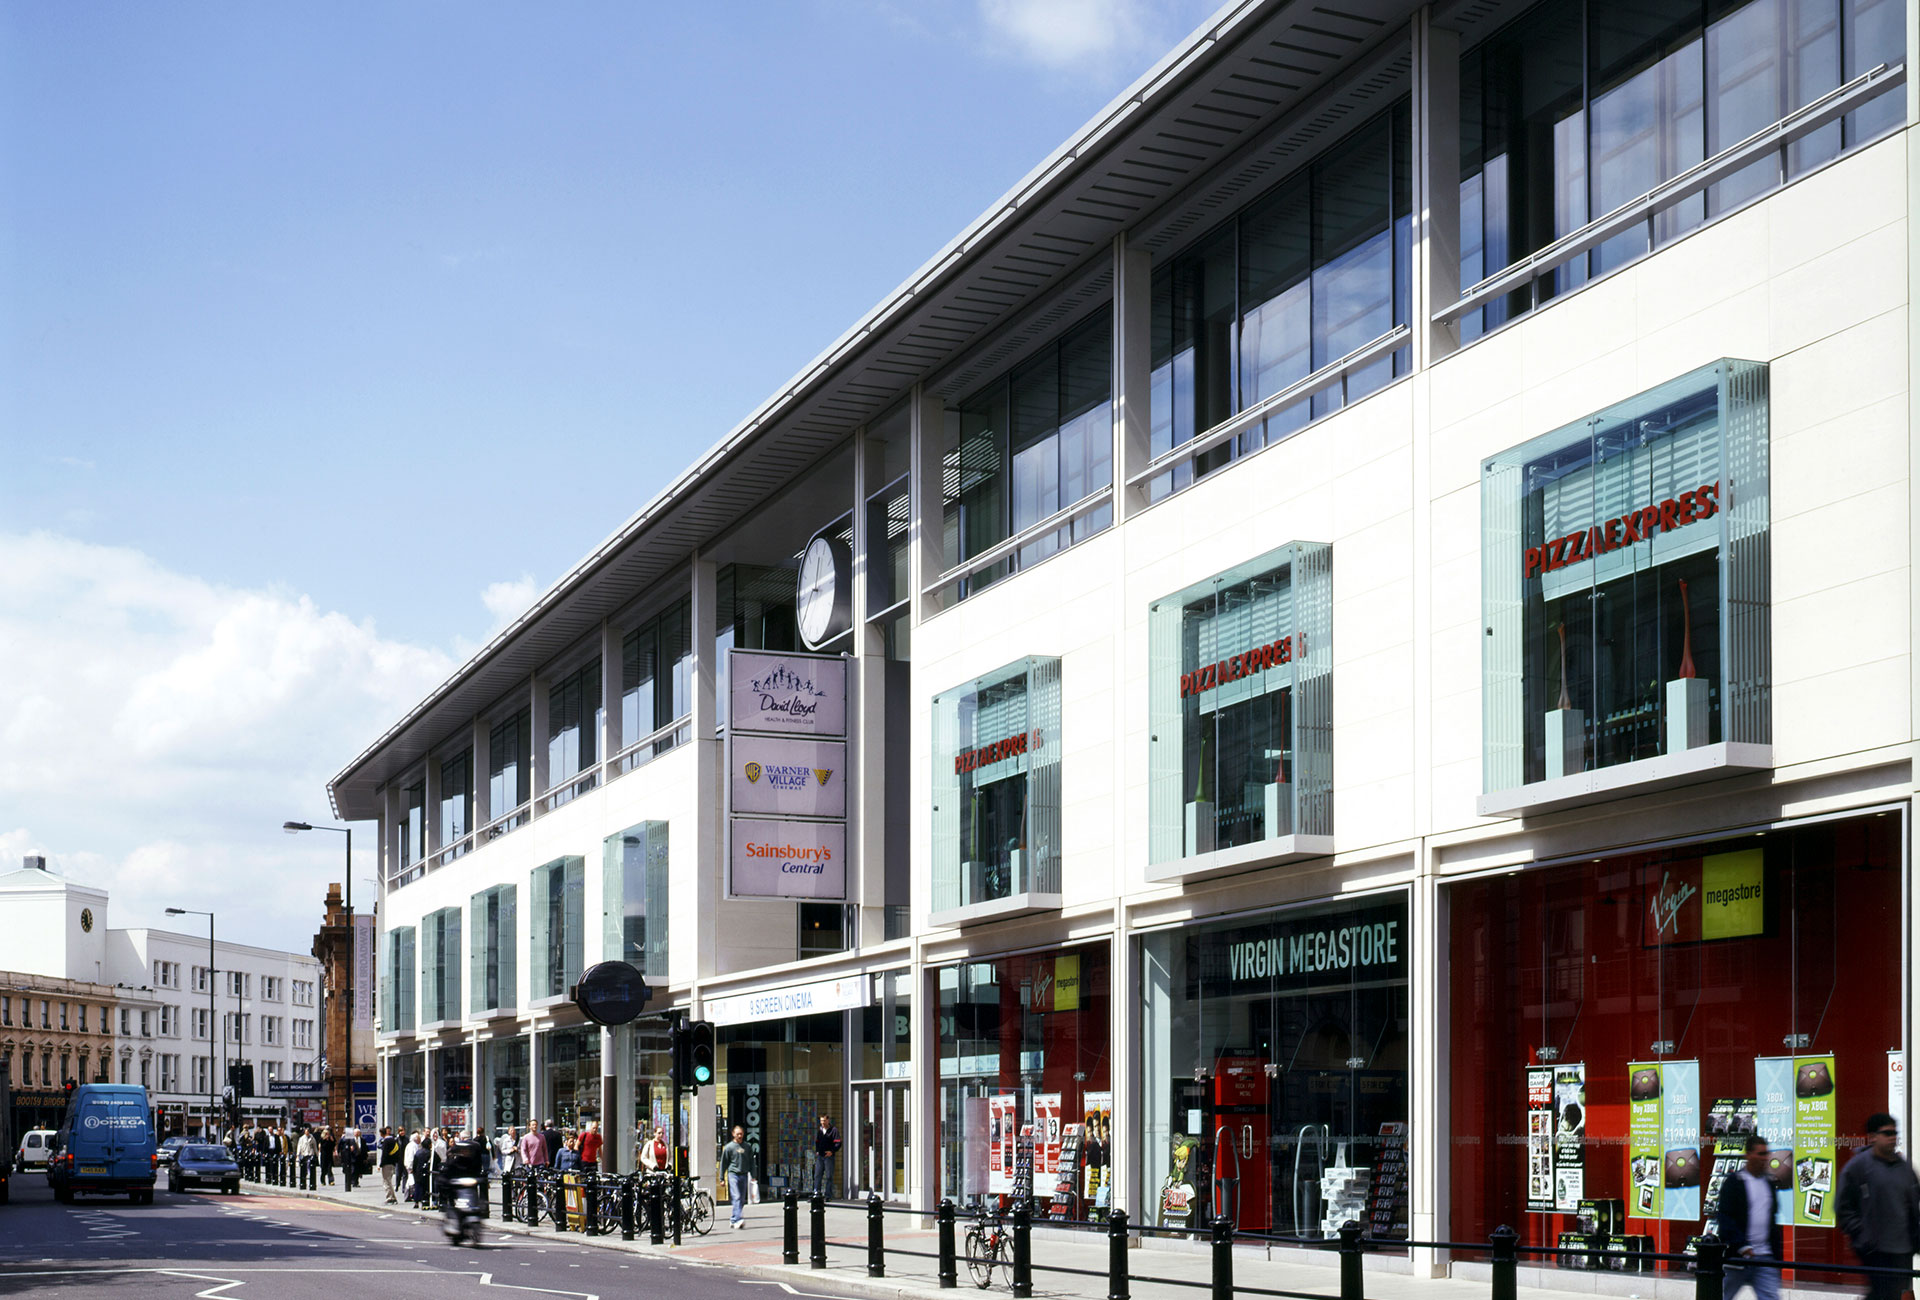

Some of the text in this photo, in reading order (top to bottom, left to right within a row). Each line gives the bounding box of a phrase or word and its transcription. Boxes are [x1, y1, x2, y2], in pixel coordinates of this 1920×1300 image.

[759, 693, 817, 717] David Lloyd
[765, 765, 810, 776] WARNER
[768, 775, 806, 786] VILLAGE
[746, 842, 831, 863] Sainsbury's
[781, 862, 824, 874] Central
[1649, 871, 1761, 936] Virgin megastore
[1230, 921, 1397, 981] VIRGIN MEGASTORE
[358, 924, 369, 1020] FULHAM BROADWAY
[750, 1000, 754, 1015] 9
[756, 996, 783, 1015] SCREEN
[785, 992, 813, 1011] CINEMA
[1529, 1094, 1550, 1102] FREE
[1798, 1102, 1811, 1113] Buy
[1811, 1101, 1828, 1111] XBOX
[746, 1084, 760, 1154] BOOKS
[1633, 1103, 1657, 1115] Buy XBOX
